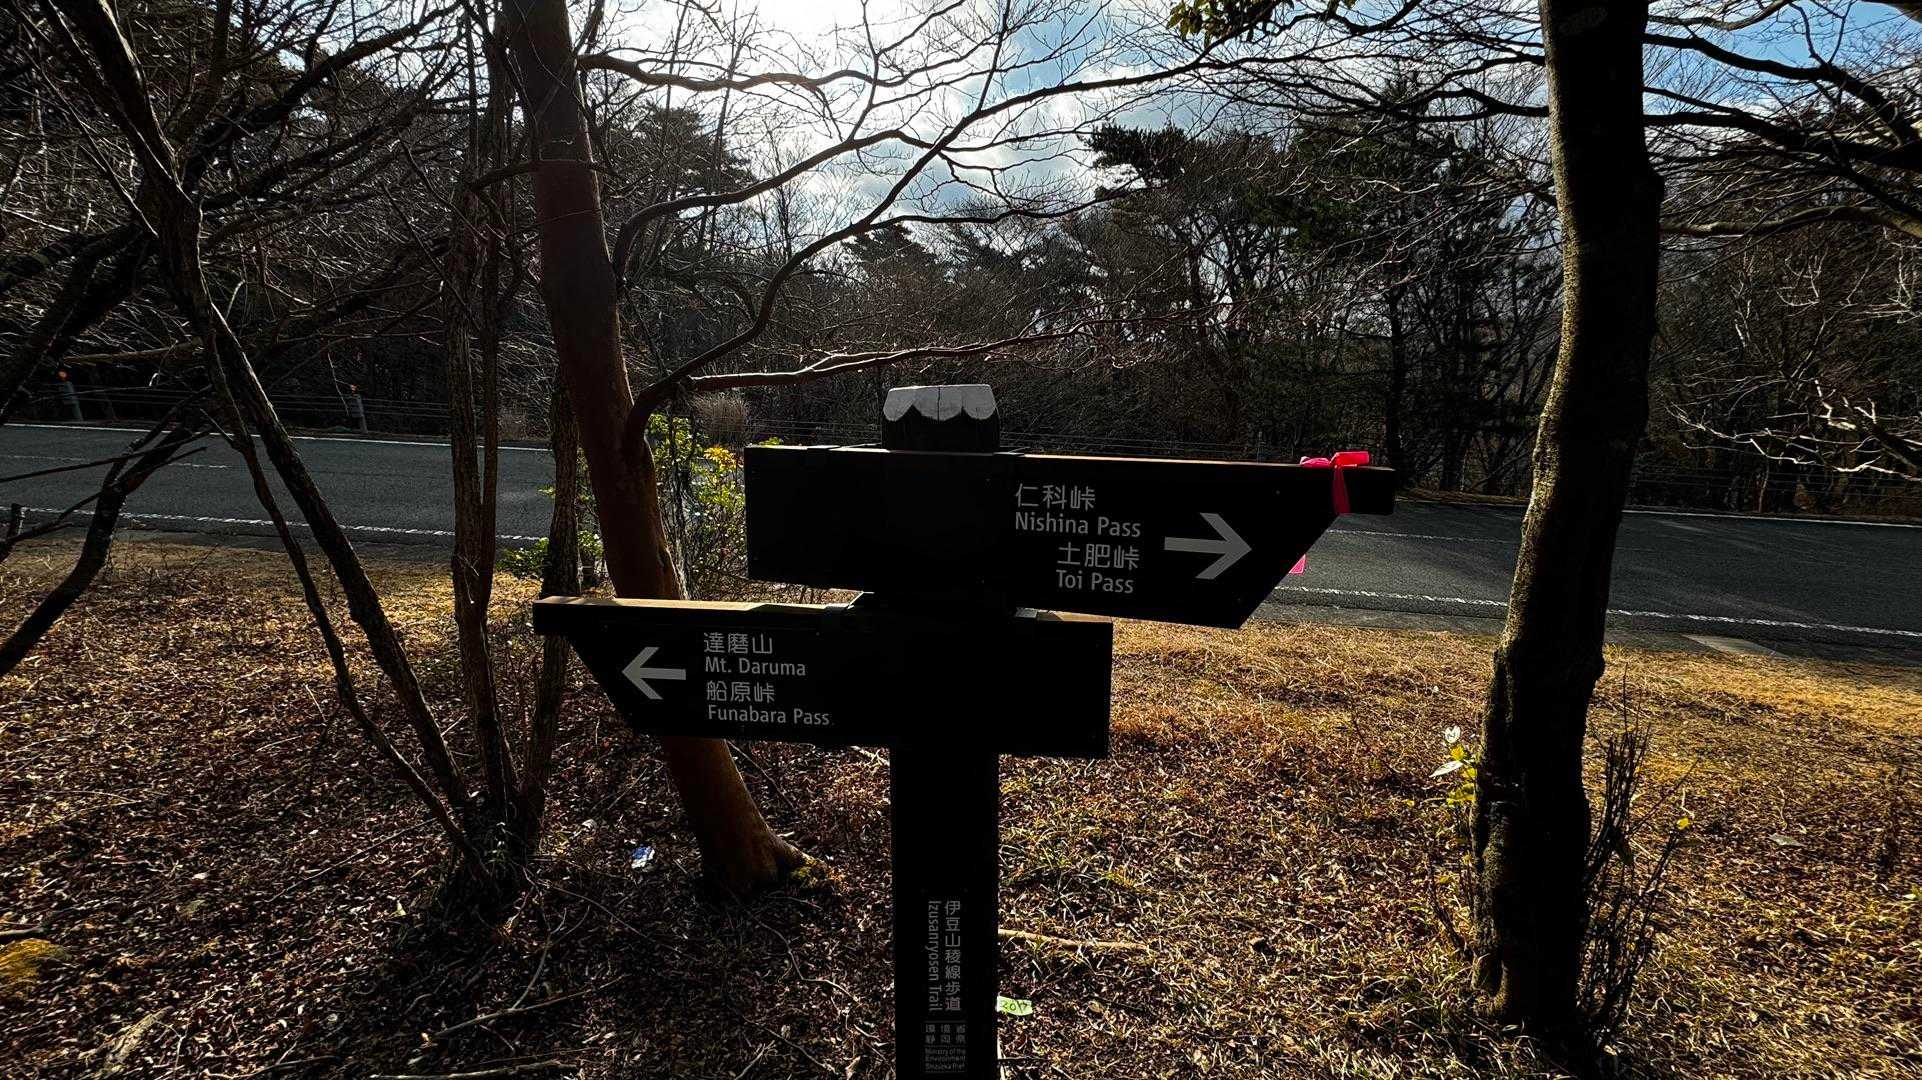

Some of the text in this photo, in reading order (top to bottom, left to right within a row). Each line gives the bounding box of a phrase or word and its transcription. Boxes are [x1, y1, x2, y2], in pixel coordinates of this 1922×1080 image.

[1015, 483, 1096, 511] 仁科峠
[1015, 511, 1142, 538] Nishina Pass
[1056, 542, 1141, 571] 土肥峠
[1056, 569, 1135, 593] Toi Pass
[703, 632, 773, 654] 達磨山
[704, 656, 807, 677] Mt. Daruma
[705, 680, 775, 703] 船原峠
[707, 704, 831, 726] Funabara Pass
[926, 900, 943, 1011] Izusanryosen Trail
[944, 900, 961, 1011] 伊豆山稜線歩道
